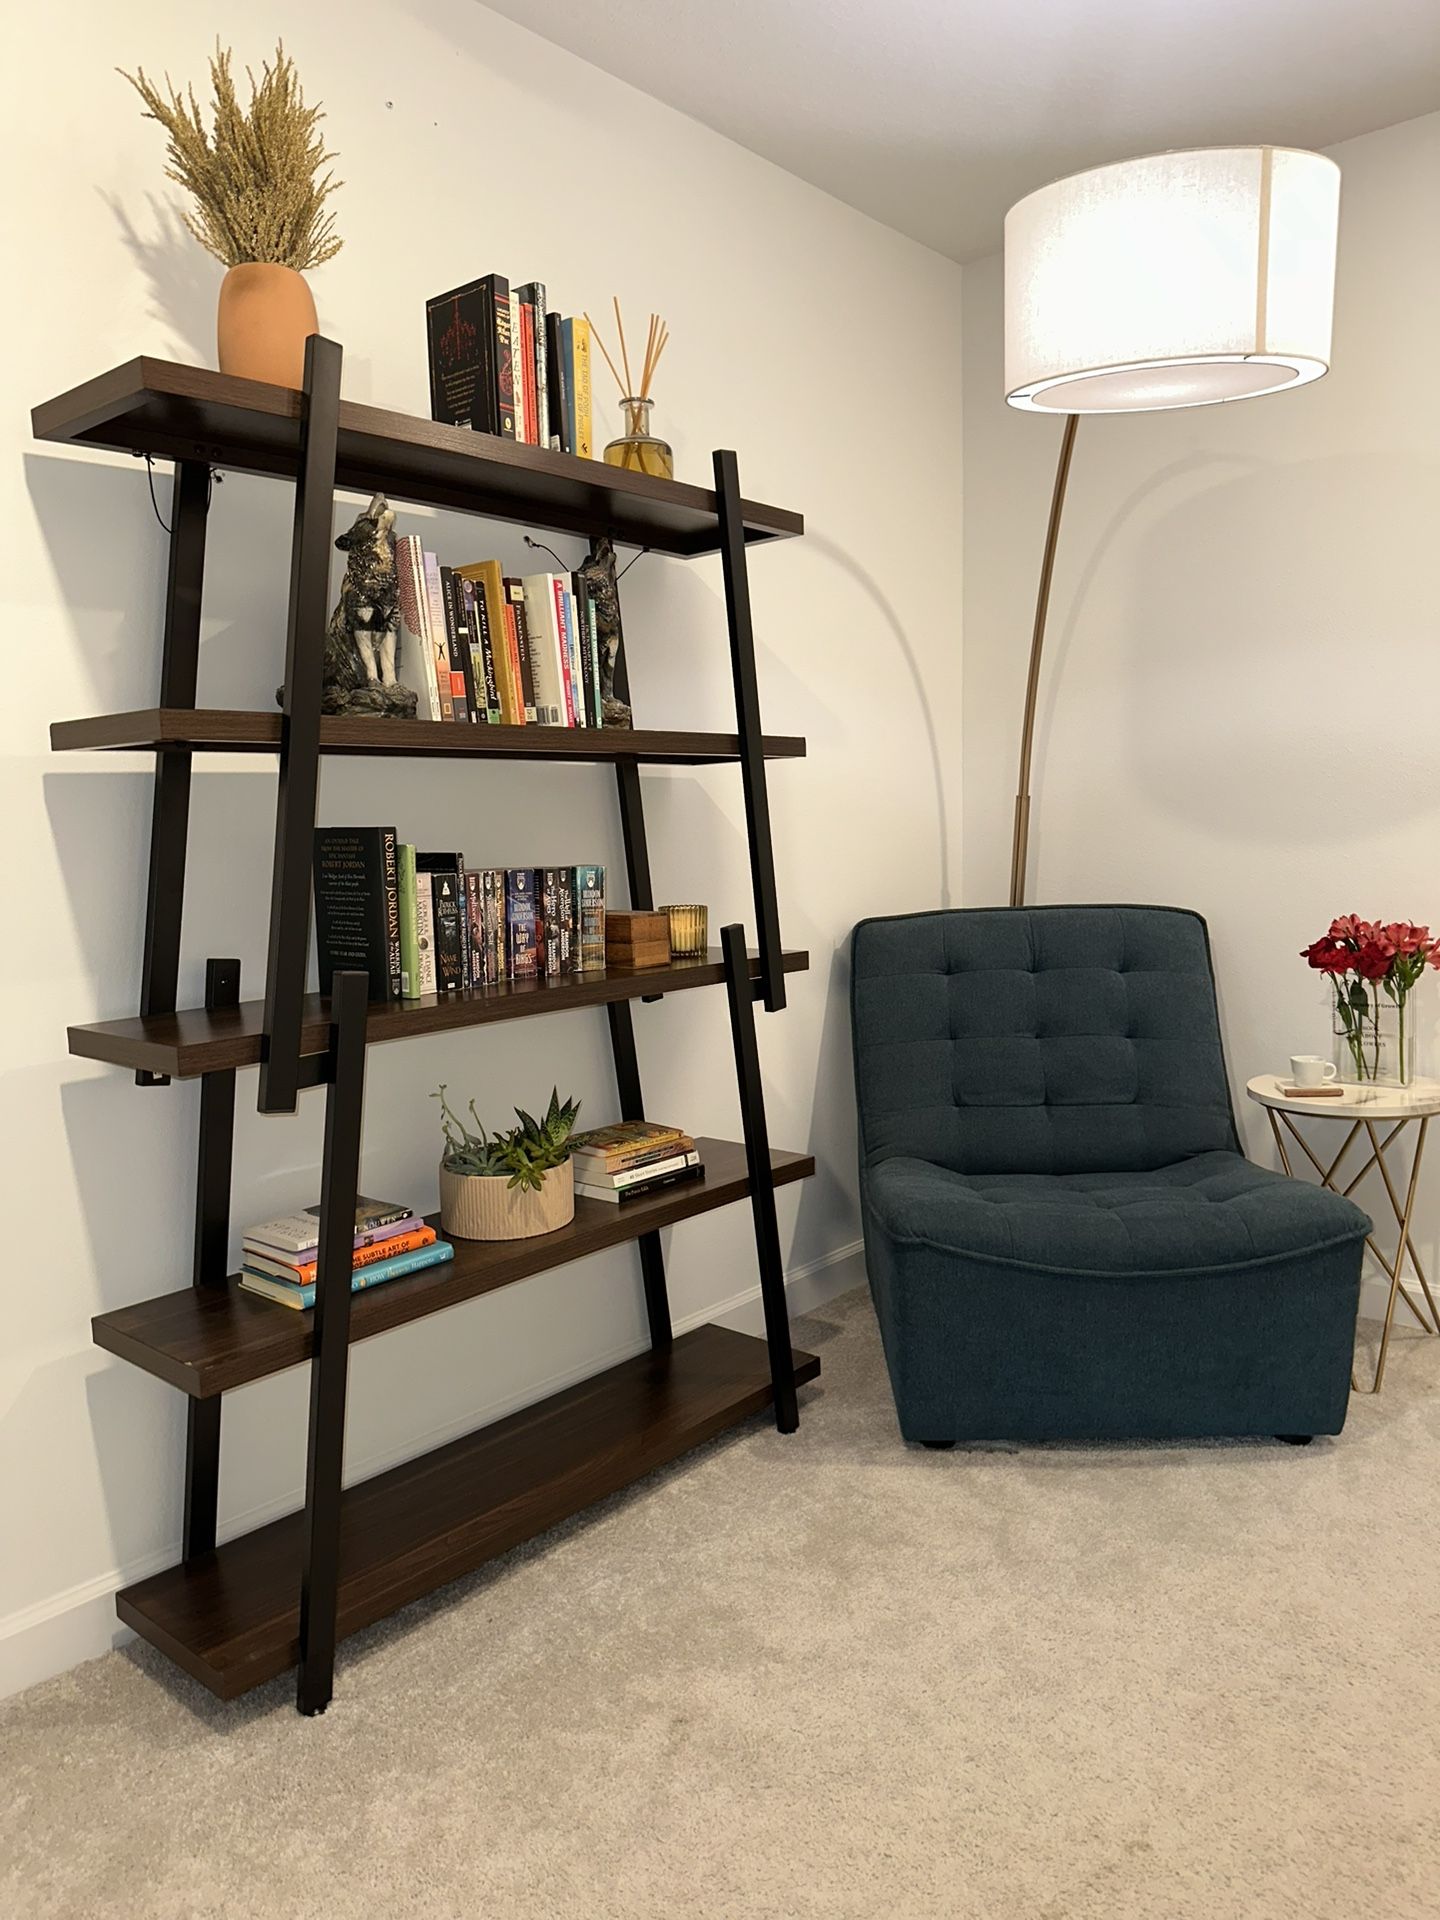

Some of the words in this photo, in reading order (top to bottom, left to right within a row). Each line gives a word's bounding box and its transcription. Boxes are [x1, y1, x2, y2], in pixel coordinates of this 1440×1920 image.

[583, 385, 589, 396] OF
[448, 601, 454, 609] IN
[480, 600, 485, 611] TO
[557, 588, 567, 629] BRILLIANT
[449, 610, 459, 657] WONDERLAND
[515, 605, 526, 662] FRANKENSTEIN
[484, 638, 489, 646] A
[560, 631, 570, 670] MADNESS
[485, 648, 498, 701] Mockingbird
[342, 860, 366, 869] JORDAN
[384, 833, 396, 883] ROBERT
[385, 884, 399, 938] JORDAN
[416, 901, 424, 936] MARTIN
[518, 923, 527, 932] THE
[440, 953, 457, 964] NAME
[442, 966, 461, 977] WIND
[635, 1170, 645, 1179] Short
[645, 1167, 658, 1177] Stories
[362, 1249, 387, 1260] SUBTLE
[388, 1244, 400, 1252] ART
[401, 1240, 410, 1248] OF
